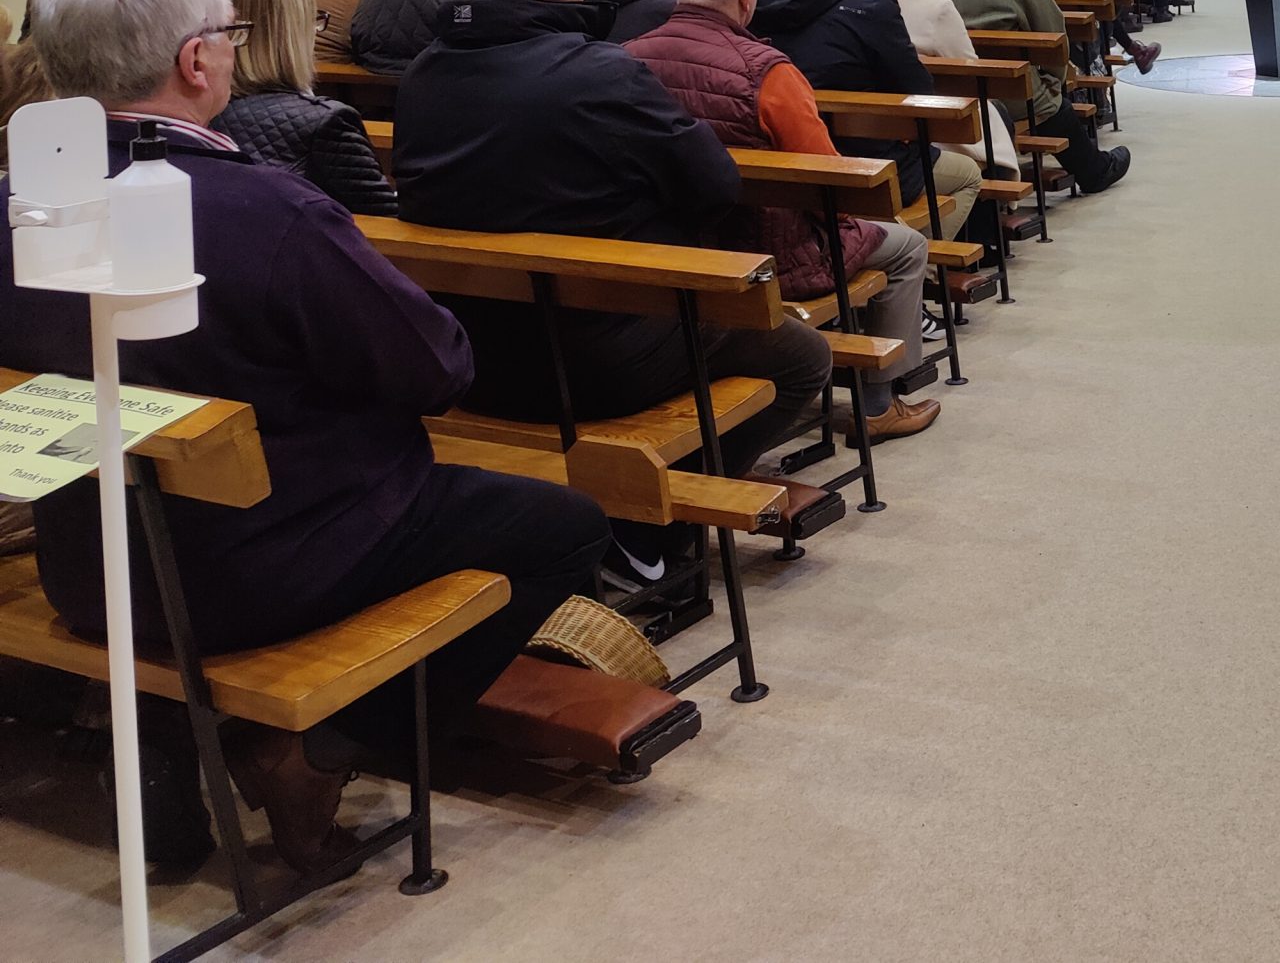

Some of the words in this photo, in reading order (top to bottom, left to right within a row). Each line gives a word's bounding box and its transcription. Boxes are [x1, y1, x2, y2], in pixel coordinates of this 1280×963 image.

[19, 383, 76, 399] Keeping
[74, 391, 140, 408] Evene
[138, 402, 174, 415] Safe
[27, 408, 79, 421] sanitize
[29, 427, 50, 436] as
[9, 468, 39, 481] Thank
[36, 475, 58, 485] you
